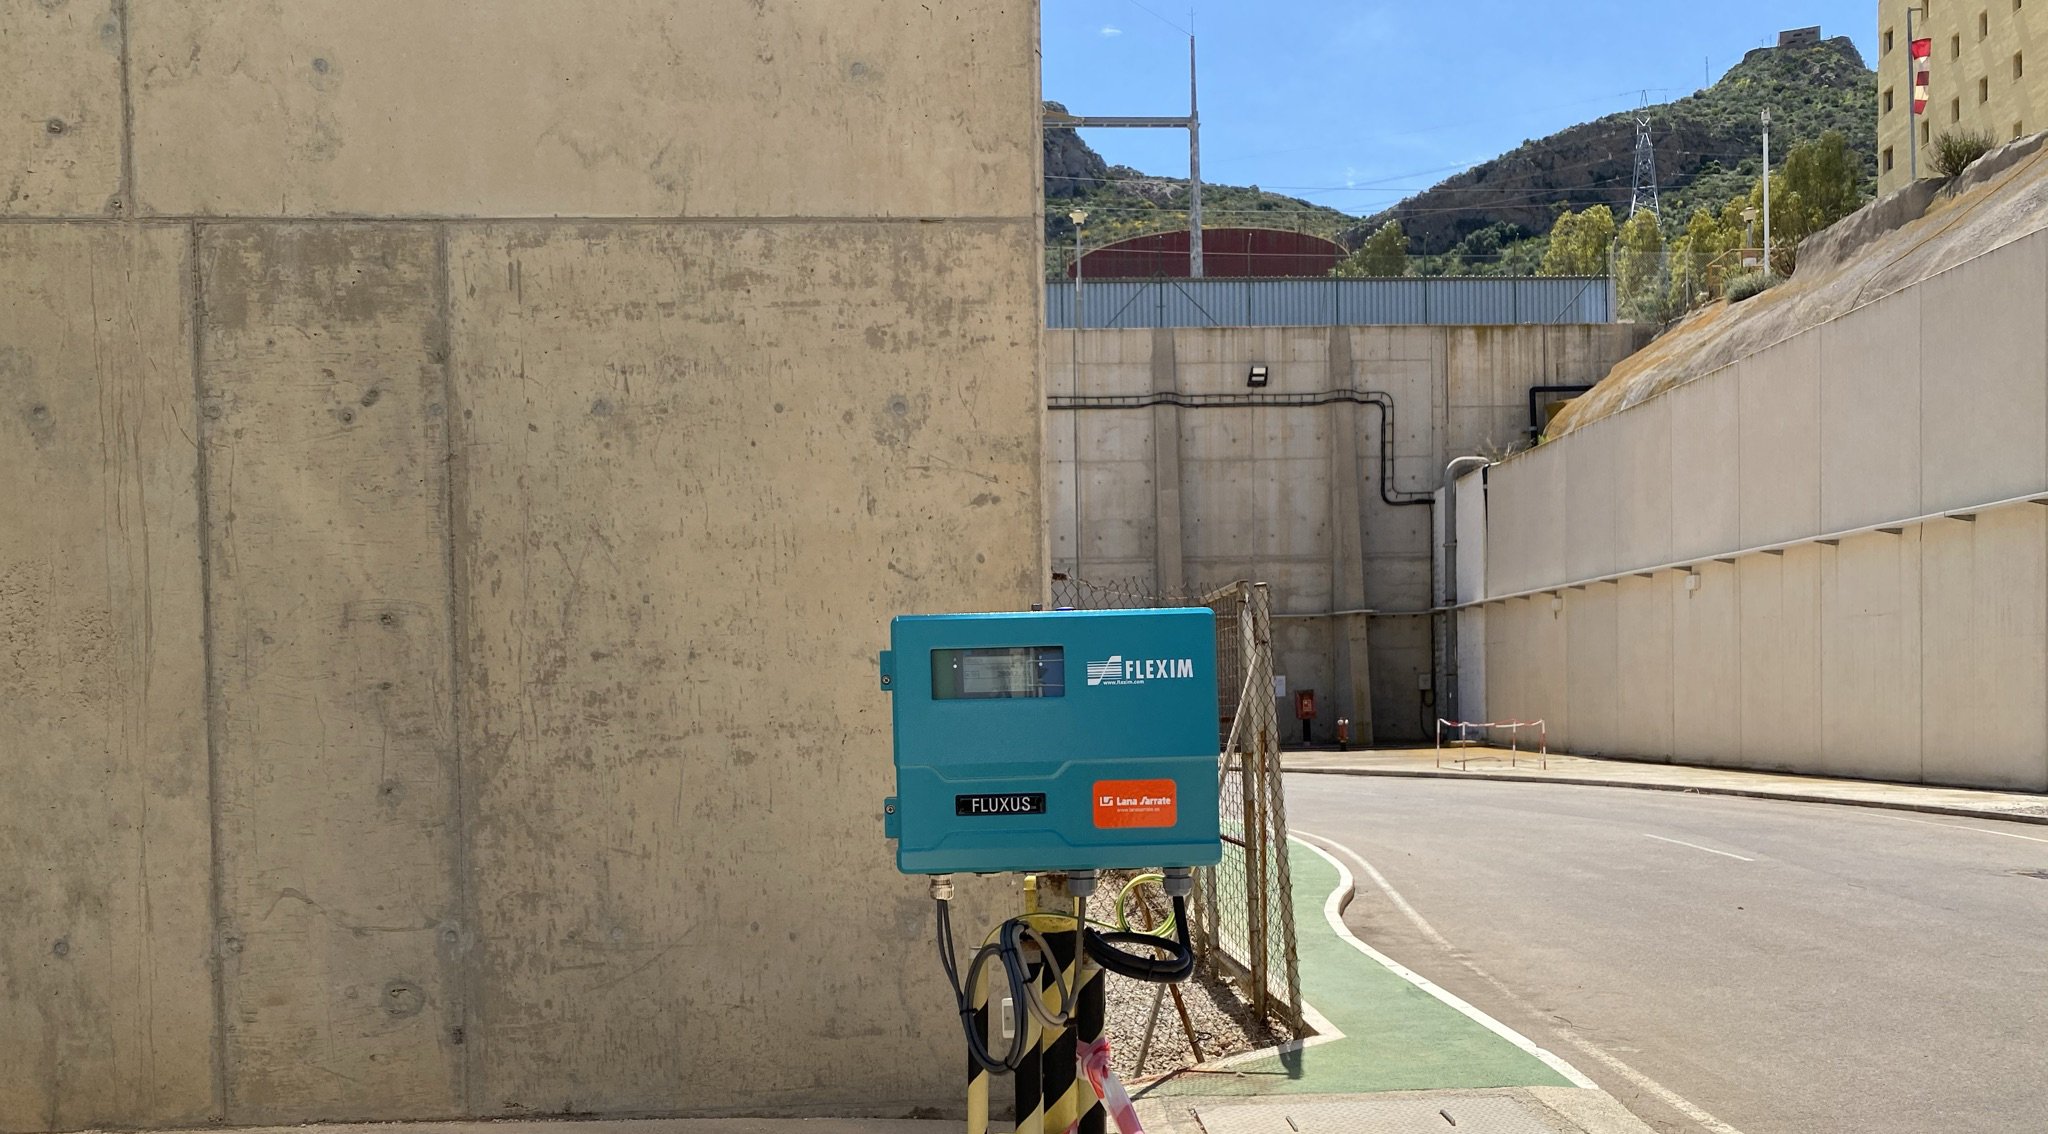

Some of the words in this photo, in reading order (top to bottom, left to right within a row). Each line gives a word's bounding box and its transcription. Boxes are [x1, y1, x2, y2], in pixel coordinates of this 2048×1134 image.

[1125, 658, 1194, 679] FLEXIM
[972, 797, 1031, 812] FLUXUS
[1117, 797, 1137, 806] Lana
[1139, 796, 1171, 805] Sarrate
